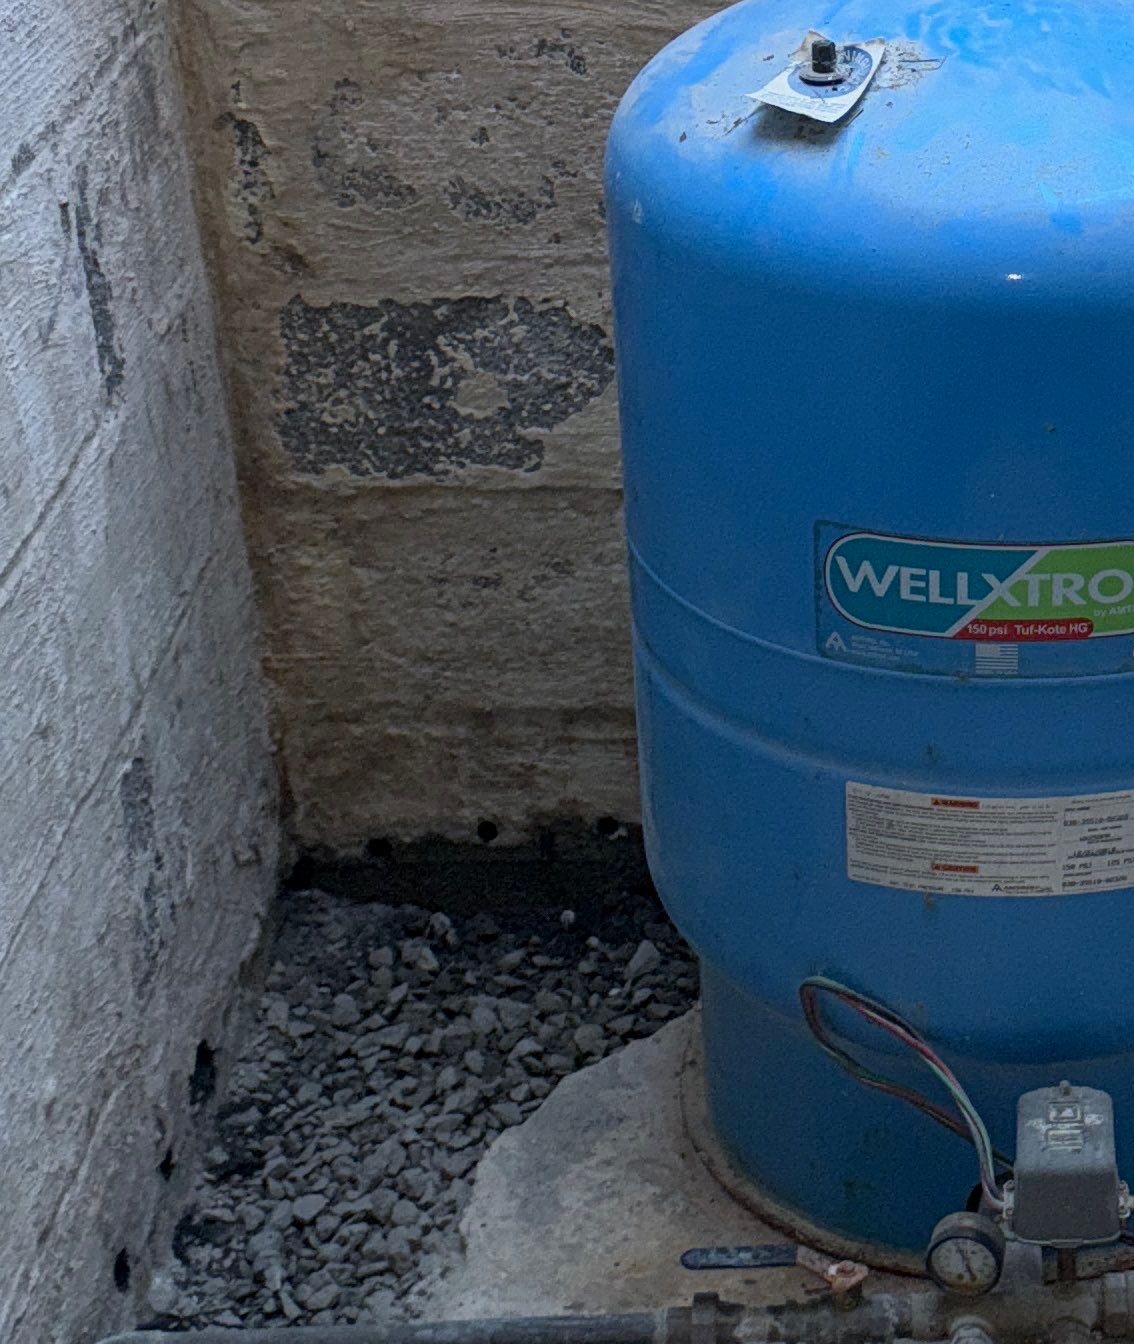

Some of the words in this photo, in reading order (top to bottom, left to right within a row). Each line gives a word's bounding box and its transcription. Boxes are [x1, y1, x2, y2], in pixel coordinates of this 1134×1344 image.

[1093, 607, 1106, 617] by
[967, 623, 986, 635] 150
[988, 623, 1008, 636] psi
[1014, 623, 1066, 636] Tuf-Kote
